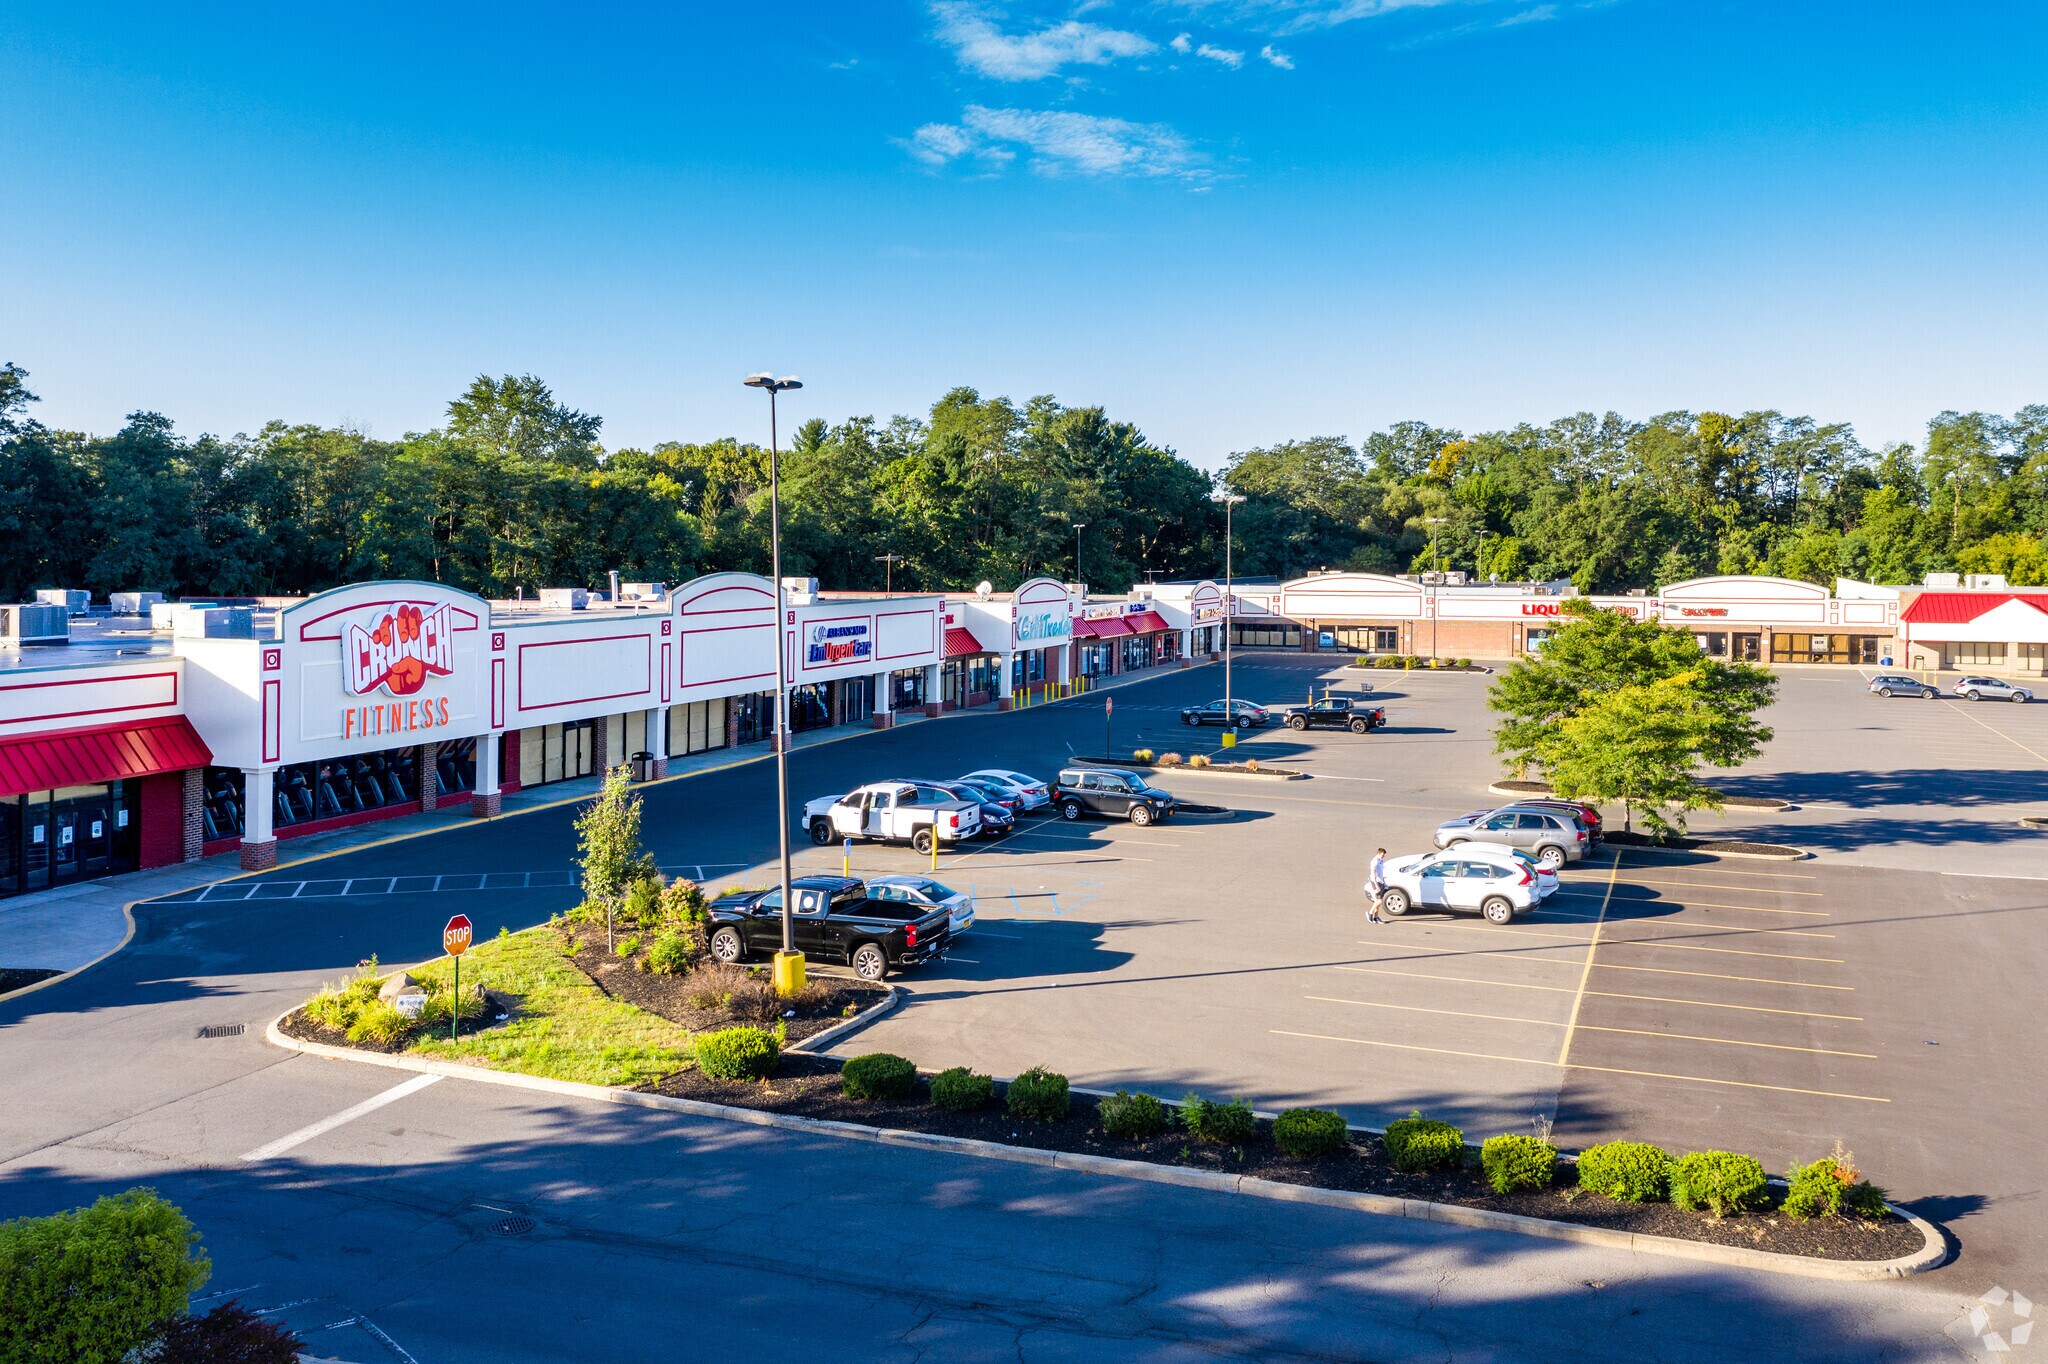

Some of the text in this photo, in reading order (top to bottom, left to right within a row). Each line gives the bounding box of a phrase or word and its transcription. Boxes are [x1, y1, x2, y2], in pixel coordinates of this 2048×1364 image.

[351, 603, 453, 694] CRUNCH
[344, 696, 449, 740] FITNESS
[446, 926, 470, 946] STOP
